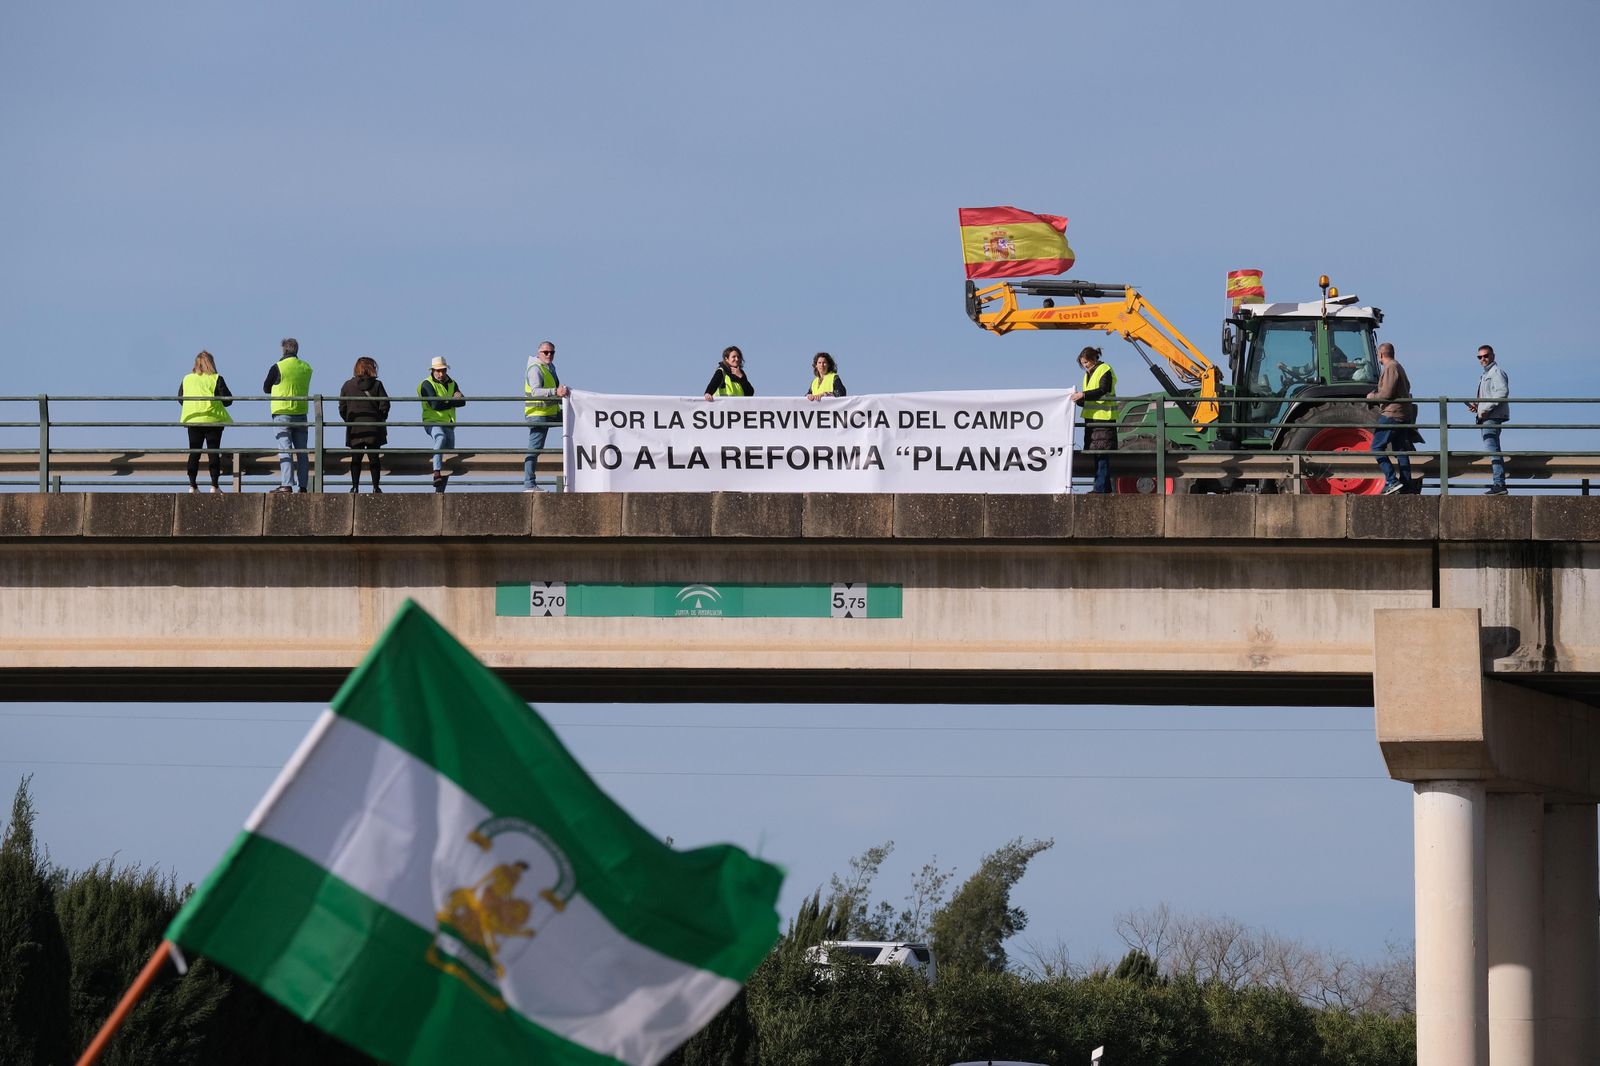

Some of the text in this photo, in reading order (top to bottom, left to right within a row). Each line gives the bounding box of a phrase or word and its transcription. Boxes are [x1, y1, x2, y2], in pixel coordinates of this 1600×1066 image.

[594, 410, 1044, 430] POR LA SUPERVIVENCIA DEL CAMPO
[576, 444, 623, 471] NO
[633, 445, 657, 470] A
[667, 446, 710, 470] LA
[720, 445, 885, 471] REFORMA
[532, 590, 565, 608] 5,70
[832, 592, 866, 610] 5,75
